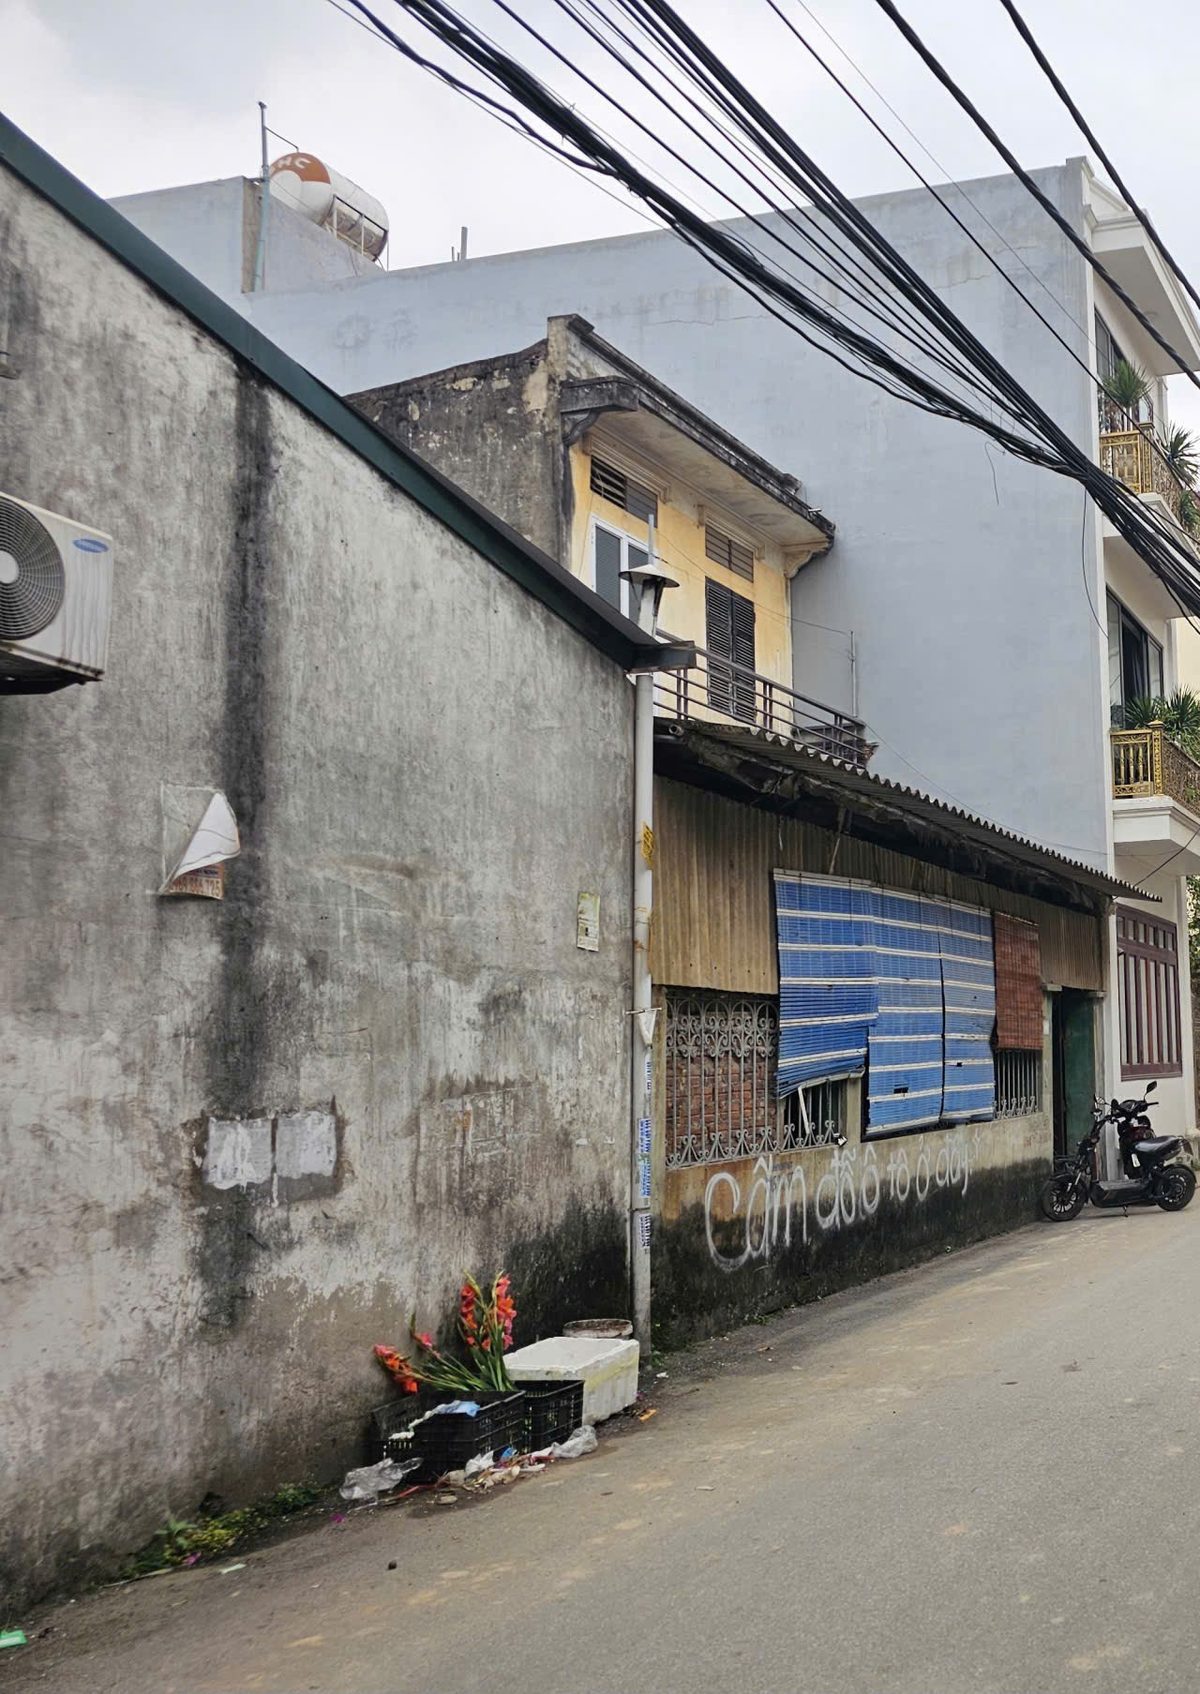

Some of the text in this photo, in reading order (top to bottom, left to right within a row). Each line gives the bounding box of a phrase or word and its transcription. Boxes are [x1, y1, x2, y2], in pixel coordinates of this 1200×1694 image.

[704, 1153, 808, 1273] Cấm
[815, 1147, 856, 1230] đỗ
[859, 1141, 880, 1218] ô
[887, 1147, 911, 1202] tô
[916, 1134, 931, 1202] ở
[935, 1132, 969, 1199] đây
